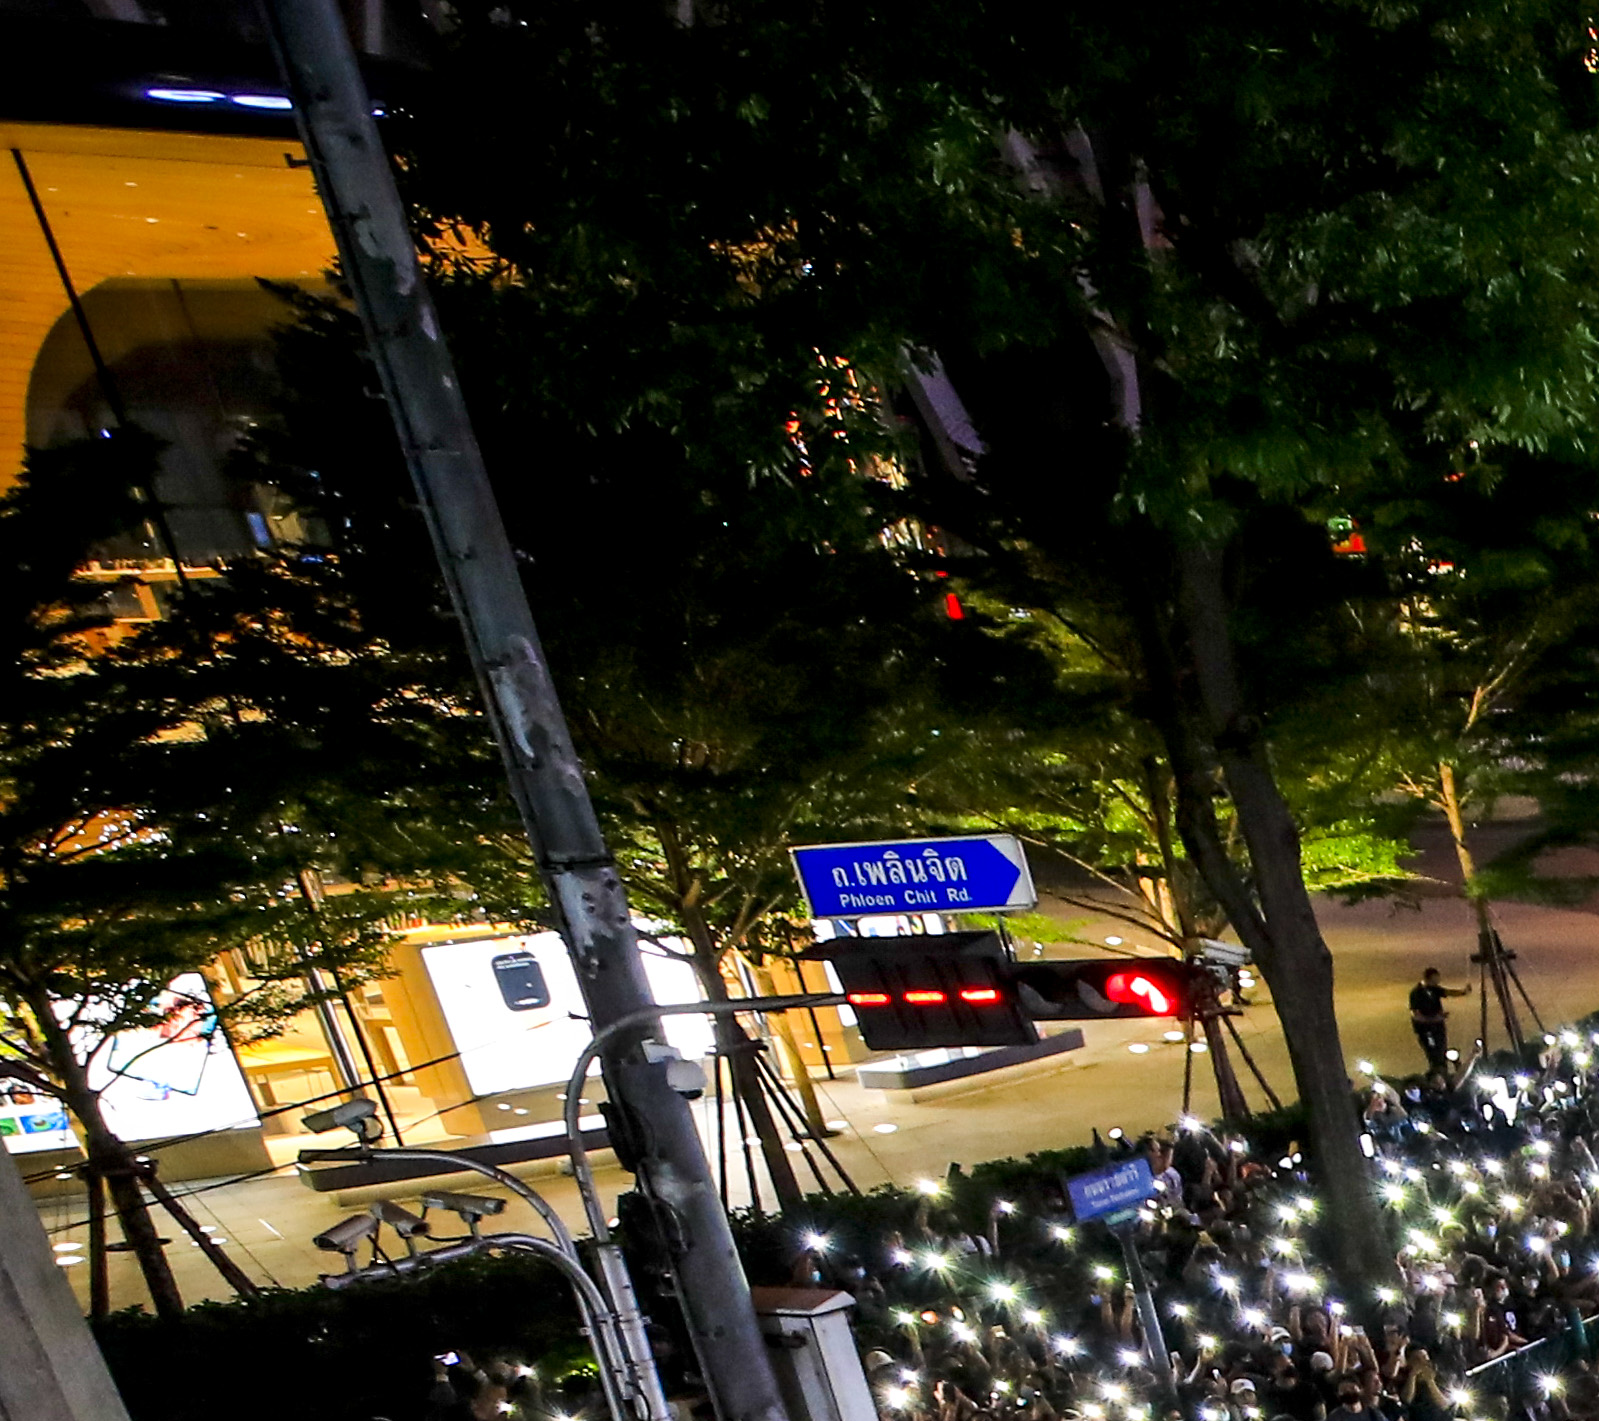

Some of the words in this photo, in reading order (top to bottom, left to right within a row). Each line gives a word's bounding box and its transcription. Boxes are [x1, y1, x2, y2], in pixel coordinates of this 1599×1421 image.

[832, 848, 968, 888] ถ.เพลินจิต
[839, 892, 895, 908] Phloen
[904, 889, 937, 904] Chit
[946, 887, 973, 902] Rd.
